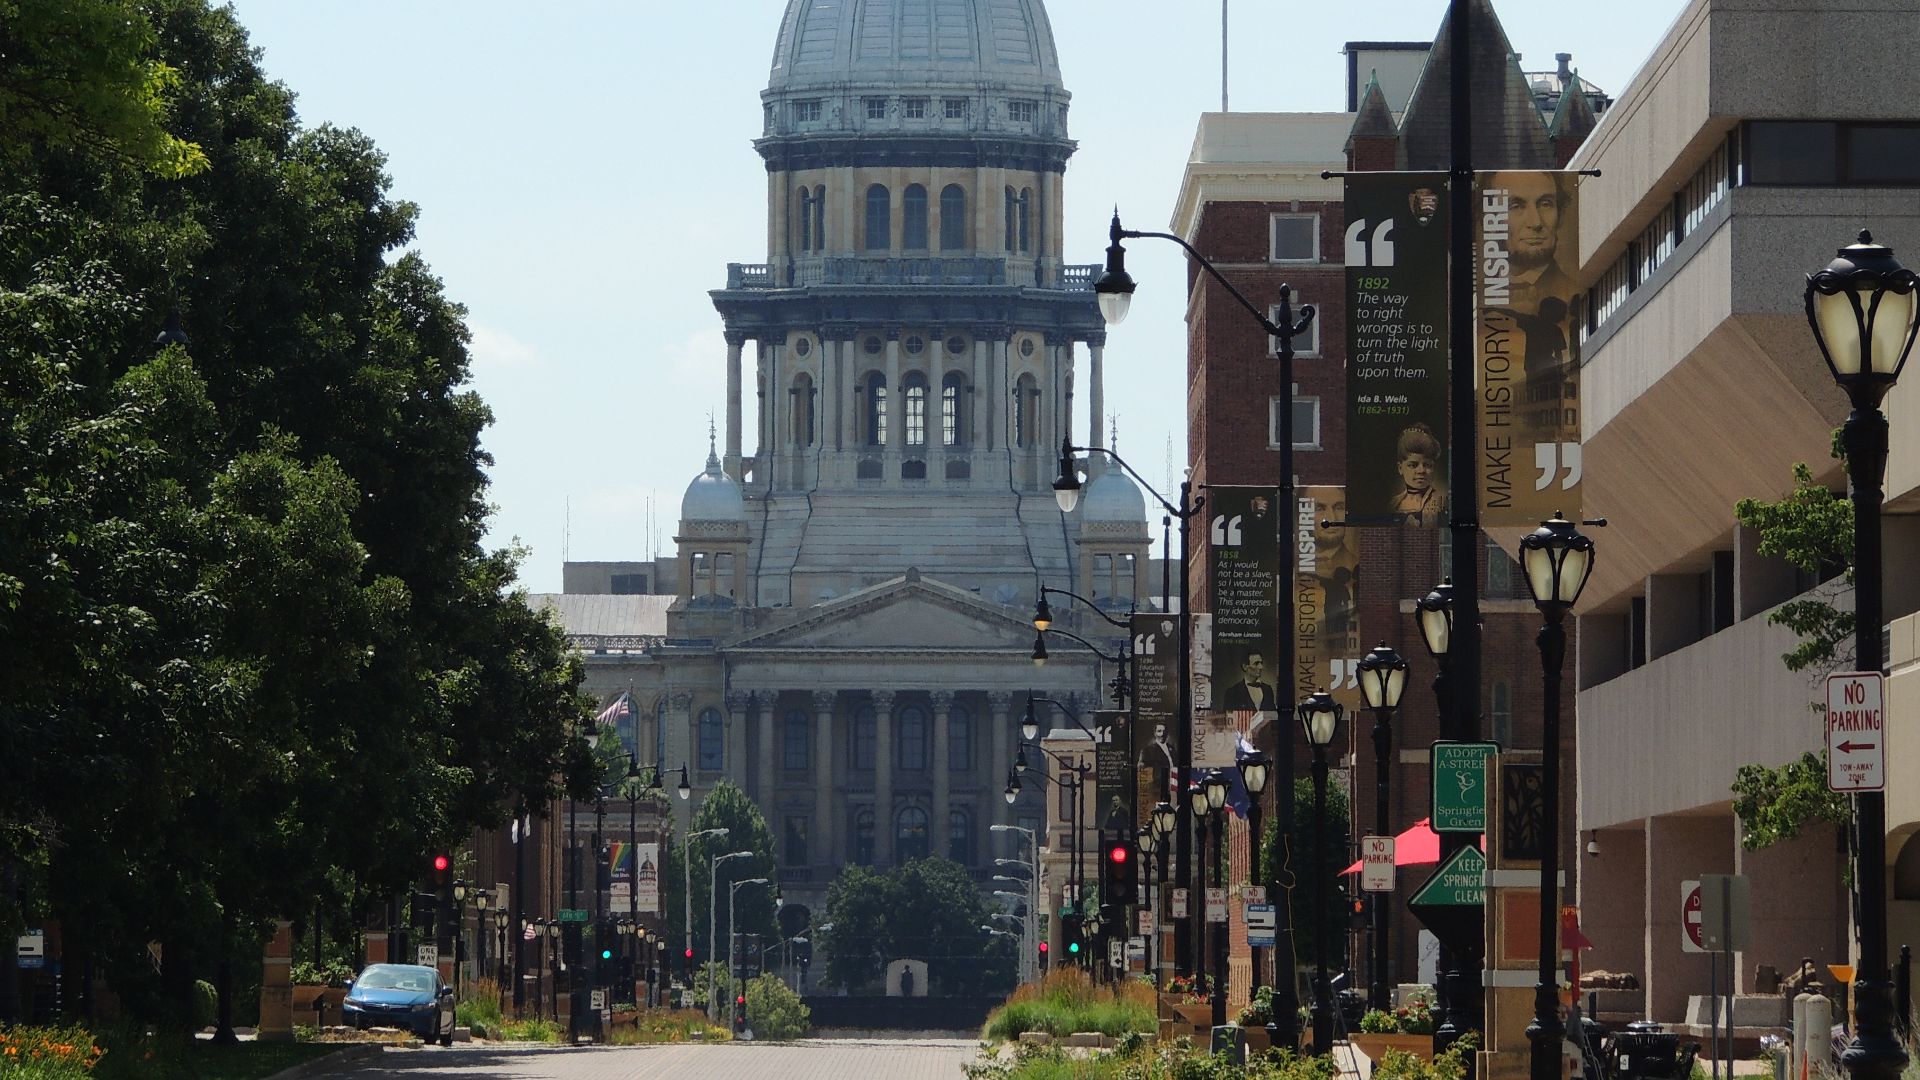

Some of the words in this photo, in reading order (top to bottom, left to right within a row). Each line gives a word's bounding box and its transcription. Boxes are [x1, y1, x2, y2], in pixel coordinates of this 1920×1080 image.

[1482, 188, 1510, 305] INSPIRE!
[1357, 277, 1390, 289] 1892
[1357, 292, 1379, 304] The
[1383, 294, 1409, 307] way
[1357, 308, 1370, 319] to
[1373, 306, 1404, 322] right
[1356, 324, 1404, 337] wrongs
[1406, 321, 1417, 334] is
[1420, 323, 1433, 335] to
[1357, 337, 1382, 349] turn
[1386, 335, 1408, 349] the
[1411, 335, 1440, 352] light
[1356, 350, 1371, 363] of
[1374, 351, 1405, 363] truth
[1356, 368, 1389, 380] upon
[1394, 365, 1429, 379] them.
[1484, 317, 1511, 427] HISTORY!
[1357, 395, 1371, 403] Ida
[1373, 395, 1382, 403] B.
[1384, 395, 1408, 403] Wells
[1486, 436, 1512, 508] MAKE
[1298, 497, 1316, 572] INSPIRE!
[1218, 561, 1228, 569] As
[1234, 561, 1259, 569] would
[1218, 570, 1231, 578] not
[1232, 570, 1243, 578] be
[1233, 579, 1258, 588] would
[1258, 580, 1273, 588] not
[1218, 588, 1228, 596] be
[1219, 597, 1233, 606] This
[1235, 599, 1271, 608] expresses
[1218, 608, 1231, 617] my
[1232, 606, 1248, 615] idea
[1250, 607, 1259, 616] of
[1299, 578, 1316, 649] HISTORY!
[1299, 655, 1316, 701] MAKE
[1844, 683, 1865, 704] NO
[1831, 709, 1880, 732] PARKING
[1194, 729, 1206, 761] MAKE
[1445, 748, 1486, 758] ADOPT
[1848, 773, 1866, 782] ZONE
[1438, 806, 1485, 816] Springfie
[1449, 817, 1482, 826] Green
[1372, 841, 1385, 852] NO
[1364, 853, 1393, 864] PARKING
[1458, 859, 1482, 871] KEEP
[1443, 875, 1483, 887] SPRINGFI
[1455, 890, 1487, 903] CLEAN
